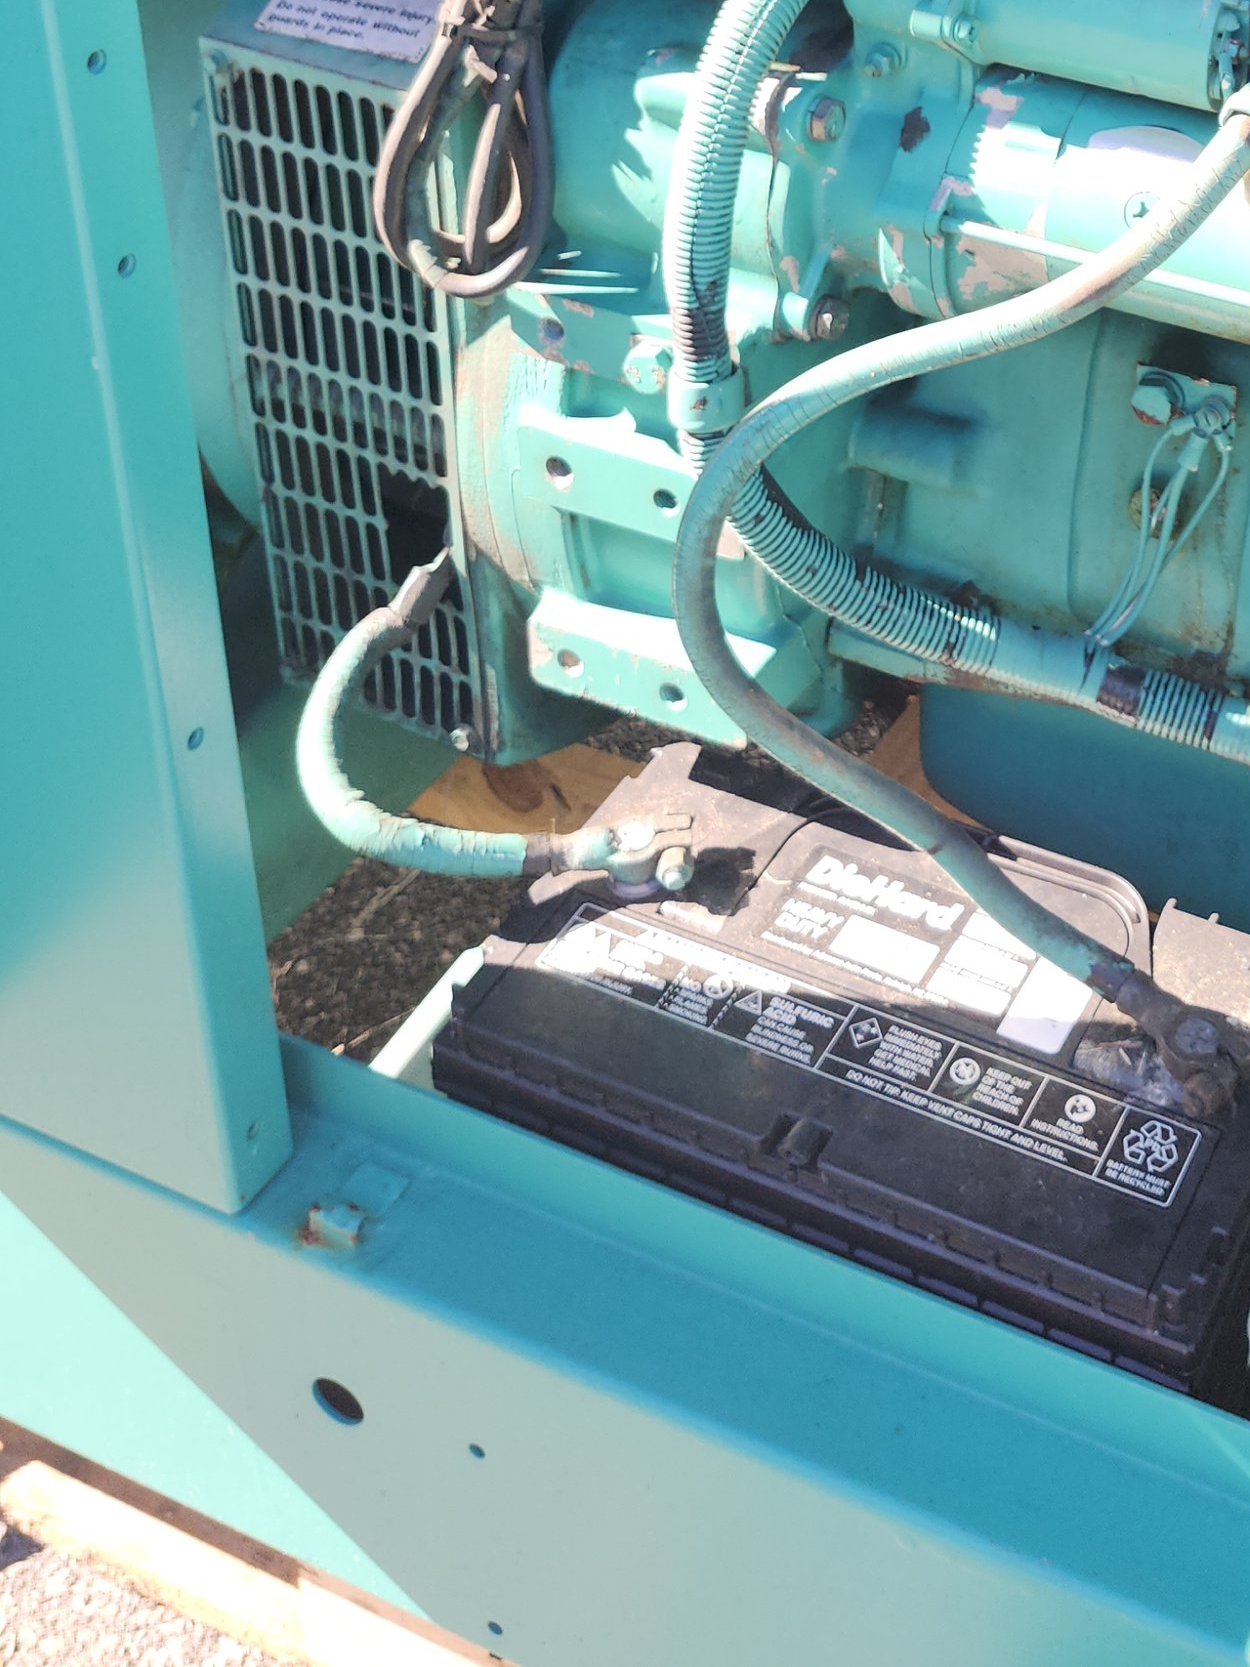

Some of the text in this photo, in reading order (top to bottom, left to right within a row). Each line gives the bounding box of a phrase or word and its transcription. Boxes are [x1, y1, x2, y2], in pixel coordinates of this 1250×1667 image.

[276, 0, 421, 38] Do not operate without
[354, 0, 396, 16] severe
[267, 13, 310, 29] guards
[312, 22, 327, 32] in
[805, 854, 965, 932] DieHard
[781, 897, 845, 929] HEAVY
[773, 910, 829, 942] DUTY
[757, 1016, 777, 1030] CAN
[761, 1006, 798, 1027] ACID
[768, 996, 835, 1029] SULFURIC
[750, 1023, 801, 1047] BLINDNESS
[889, 1024, 943, 1051] FLUSH EYES
[879, 1041, 902, 1056] WITH
[883, 1034, 942, 1061] IMMEDIATELY
[868, 1056, 892, 1072] HELP
[986, 1066, 1033, 1091] KEEP OUT
[995, 1080, 1017, 1095] THE
[975, 1084, 1010, 1103] REACH
[845, 1069, 862, 1083] DO
[861, 1074, 884, 1091] NOT
[900, 1089, 929, 1108] KEEP
[927, 1100, 955, 1119] VENT
[953, 1109, 983, 1130] CAPS
[981, 1119, 1013, 1141] TIGHT
[1010, 1131, 1035, 1149] AND
